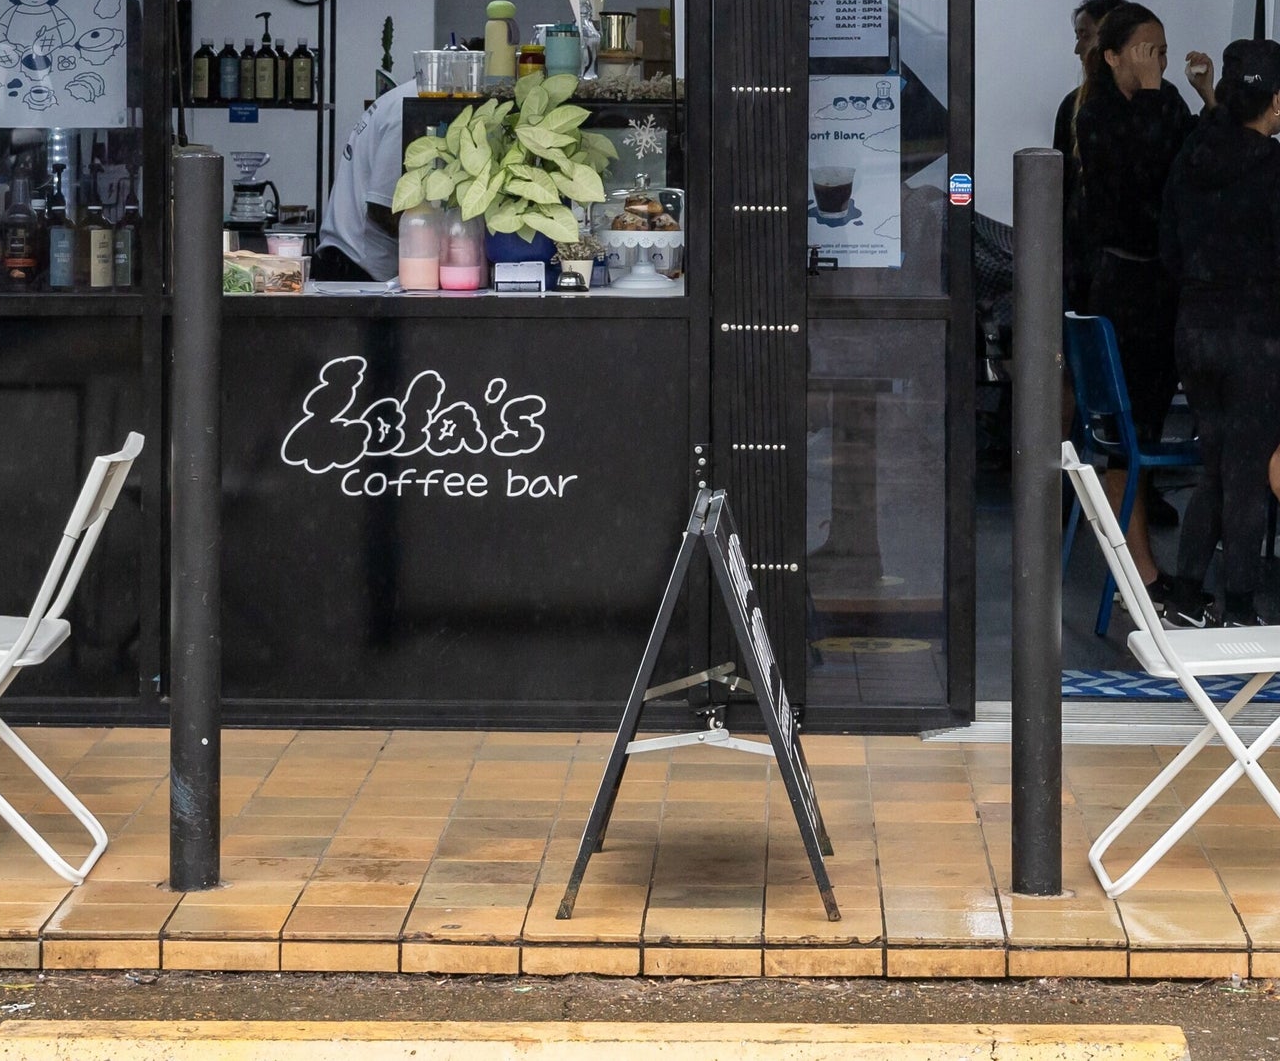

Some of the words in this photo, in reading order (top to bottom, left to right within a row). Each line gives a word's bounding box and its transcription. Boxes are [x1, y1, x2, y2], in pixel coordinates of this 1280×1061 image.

[810, 130, 831, 140] ont
[833, 130, 865, 140] Blanc
[280, 355, 547, 474] Lola's
[340, 468, 489, 497] coffee
[506, 468, 579, 498] bar
